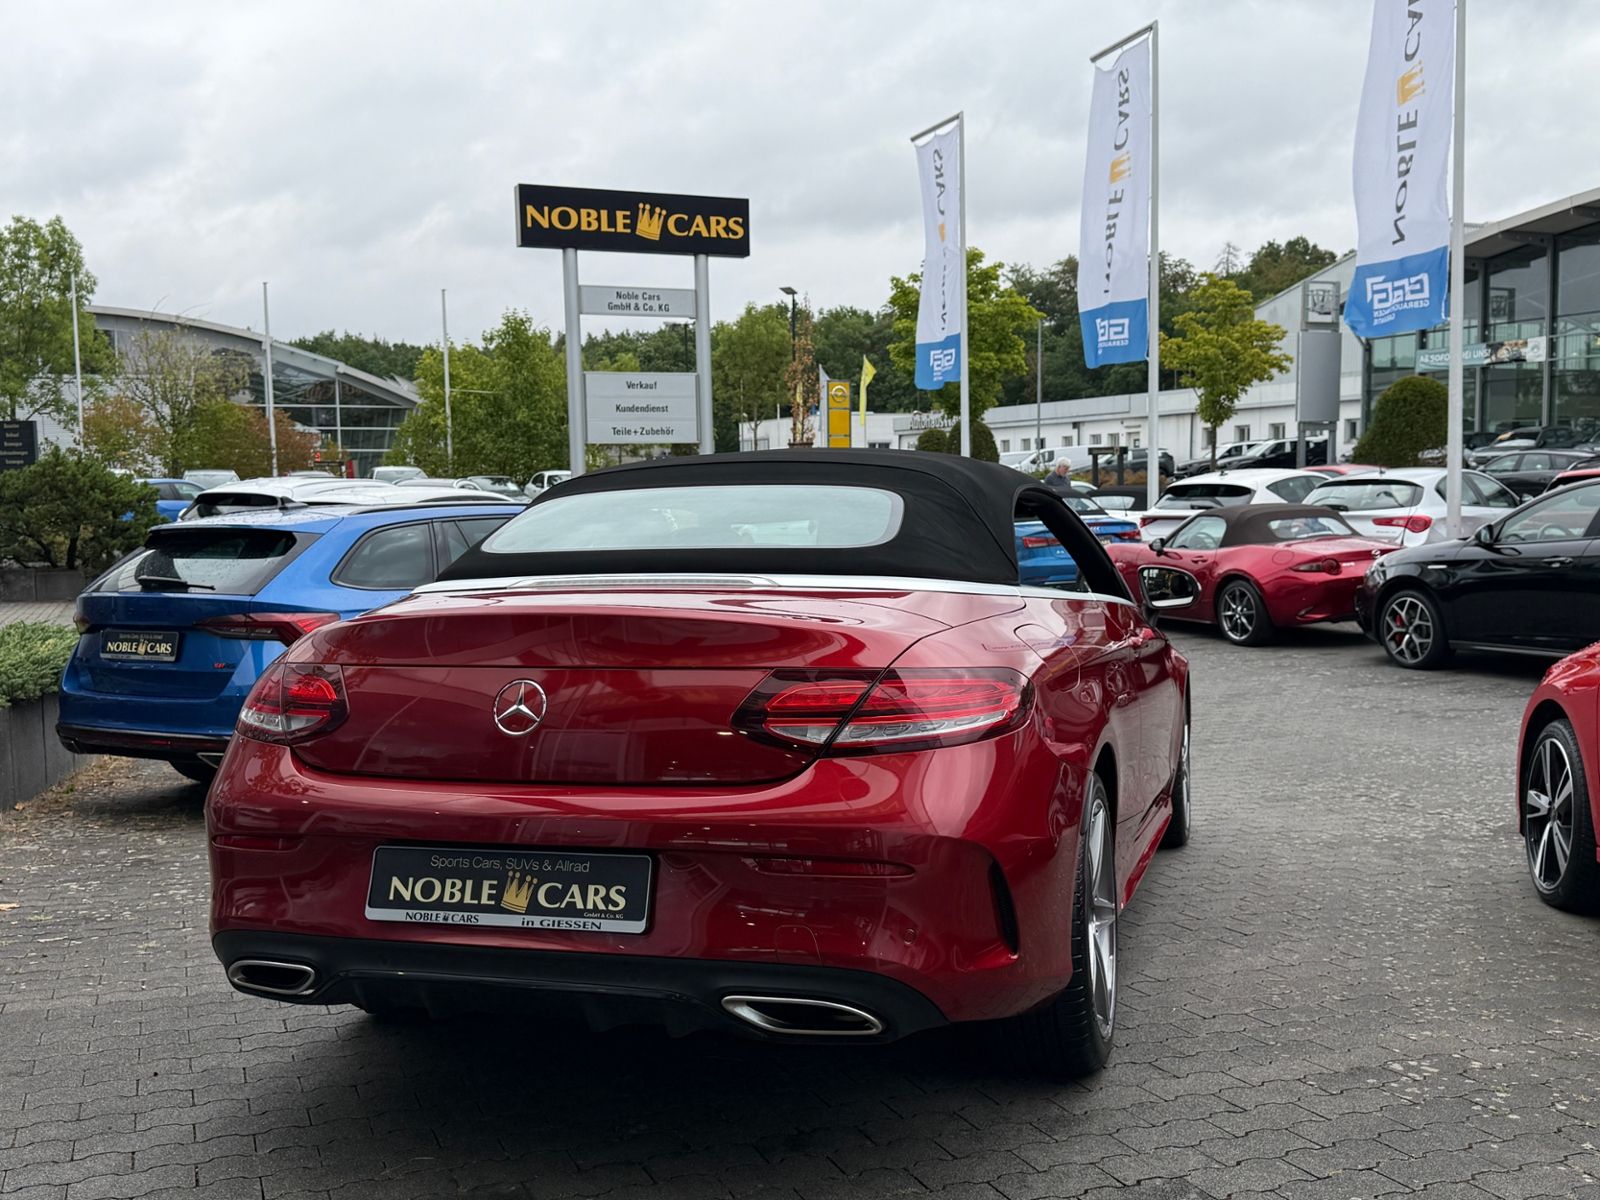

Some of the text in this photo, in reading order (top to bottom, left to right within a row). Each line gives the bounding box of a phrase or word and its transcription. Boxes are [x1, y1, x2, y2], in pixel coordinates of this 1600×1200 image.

[526, 204, 745, 240] NOBLE CARS
[615, 291, 661, 302] Noble Cars
[607, 301, 670, 313] GmbH & Co. KG
[1430, 353, 1449, 362] SOFO
[625, 380, 658, 390] Verkauf
[615, 403, 669, 413] Kundendienst
[611, 426, 675, 436] Teile+Zubehör
[106, 641, 172, 654] NOBLE CARS
[430, 855, 590, 872] Sports Cars, SUVs & Allrad
[388, 876, 627, 911] NOBLE CARS
[405, 911, 602, 930] NOBLE CARS in GIESSEN
